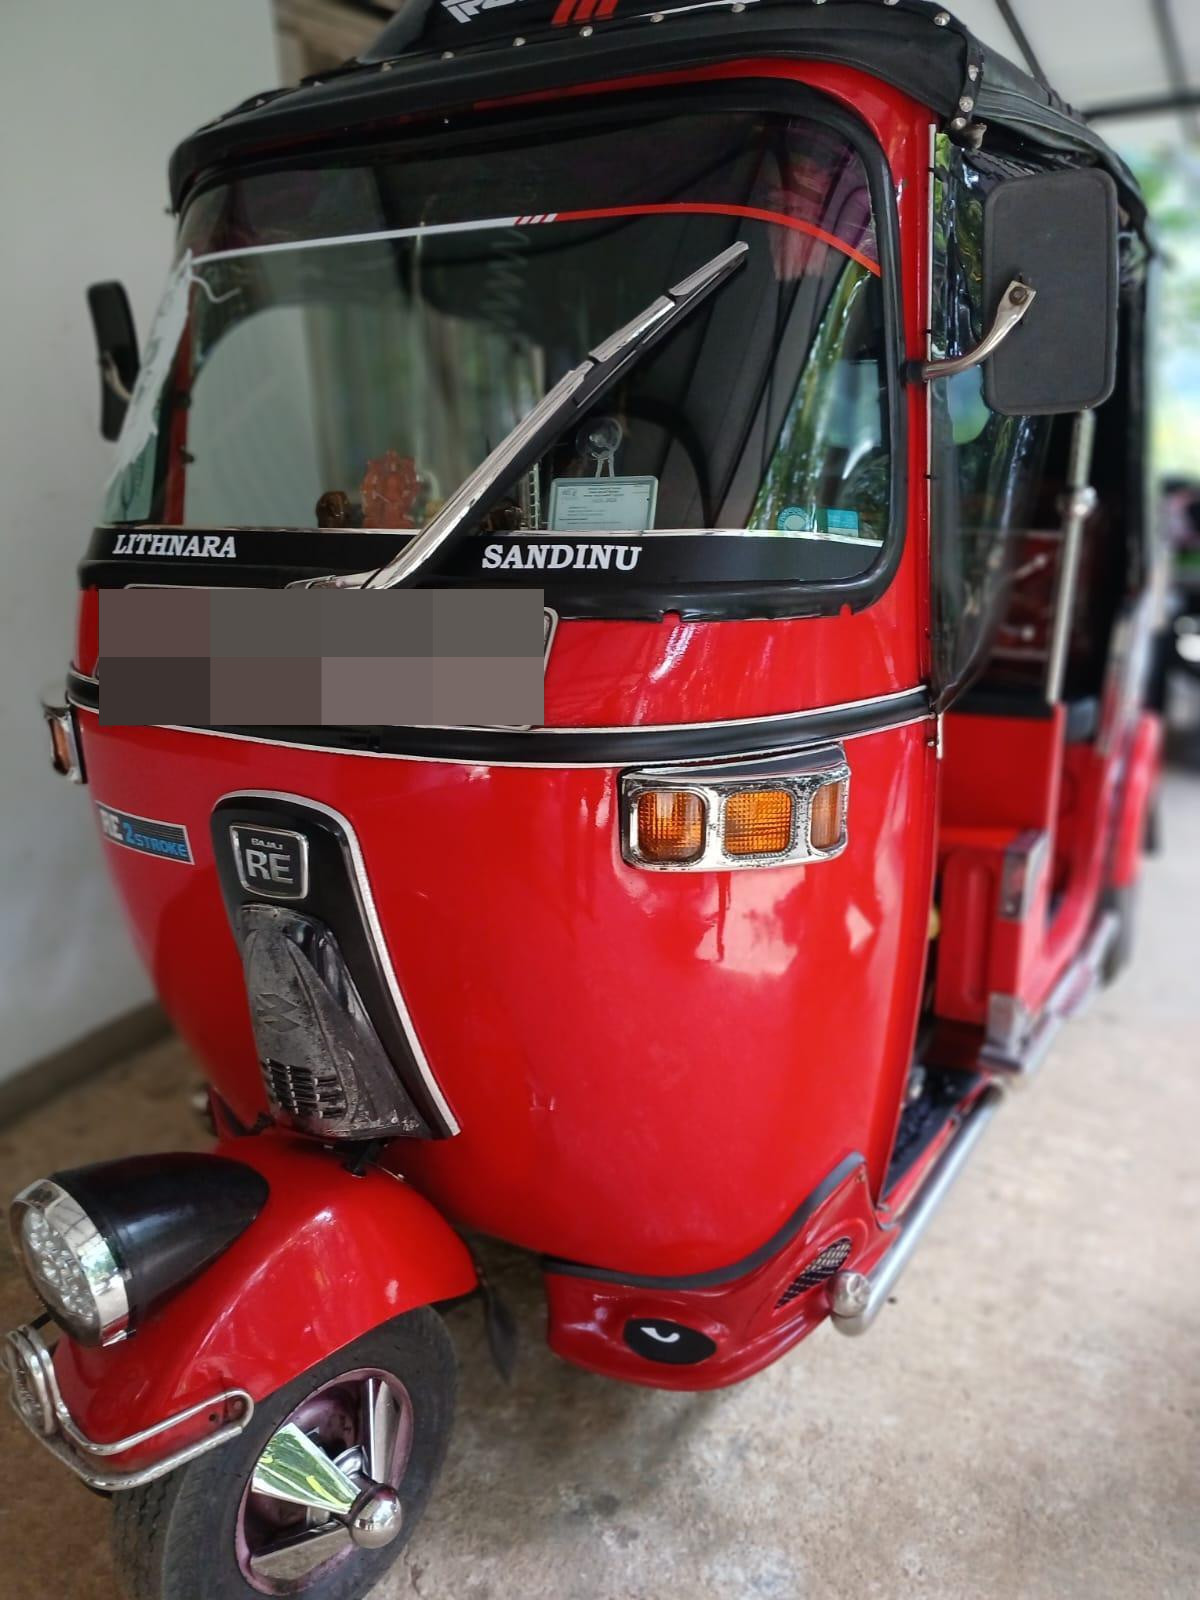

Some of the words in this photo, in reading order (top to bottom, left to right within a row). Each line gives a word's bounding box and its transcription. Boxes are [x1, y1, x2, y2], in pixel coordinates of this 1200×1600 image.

[112, 534, 237, 558] LITHNARA
[482, 544, 643, 570] SANDINU
[246, 849, 294, 884] RE
